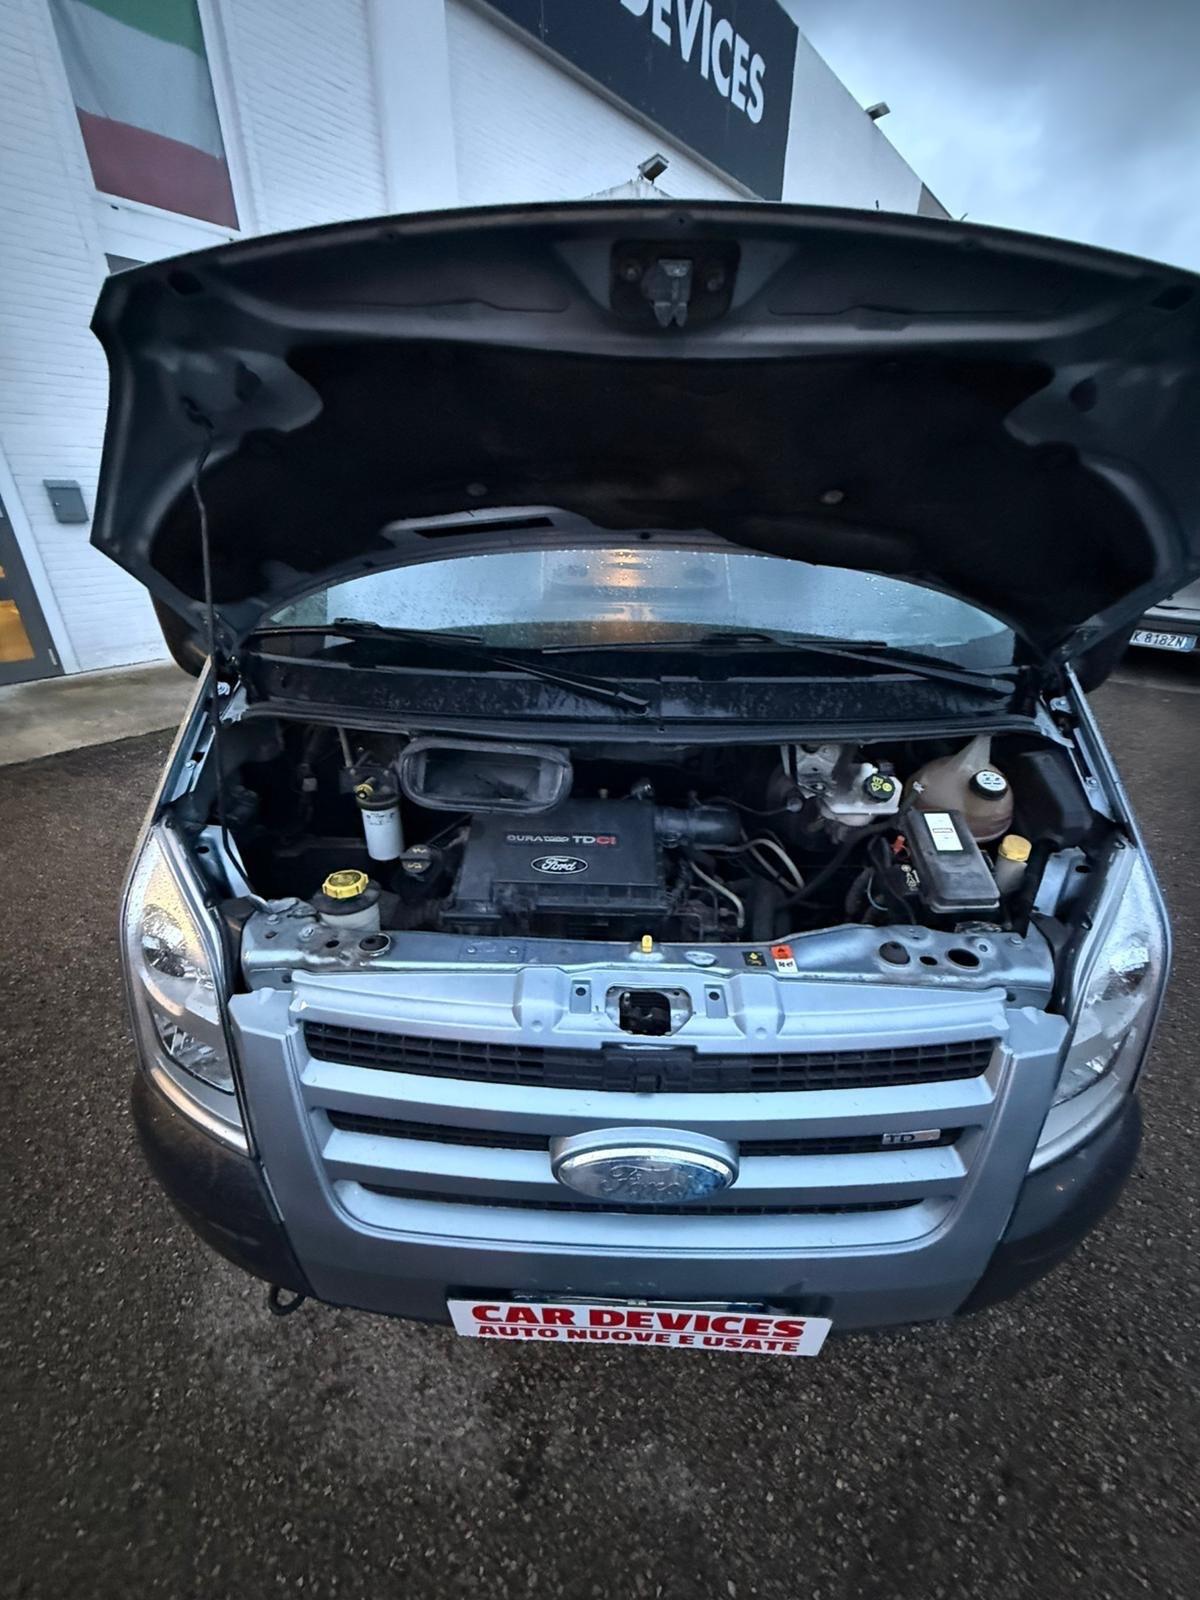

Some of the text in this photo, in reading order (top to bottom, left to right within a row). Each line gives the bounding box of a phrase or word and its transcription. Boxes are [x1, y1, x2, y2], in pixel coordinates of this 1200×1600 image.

[620, 0, 766, 124] EVICES
[472, 1305, 806, 1338] CAR DEVICES
[478, 1325, 800, 1352] AUTO NUOVE E USATE
